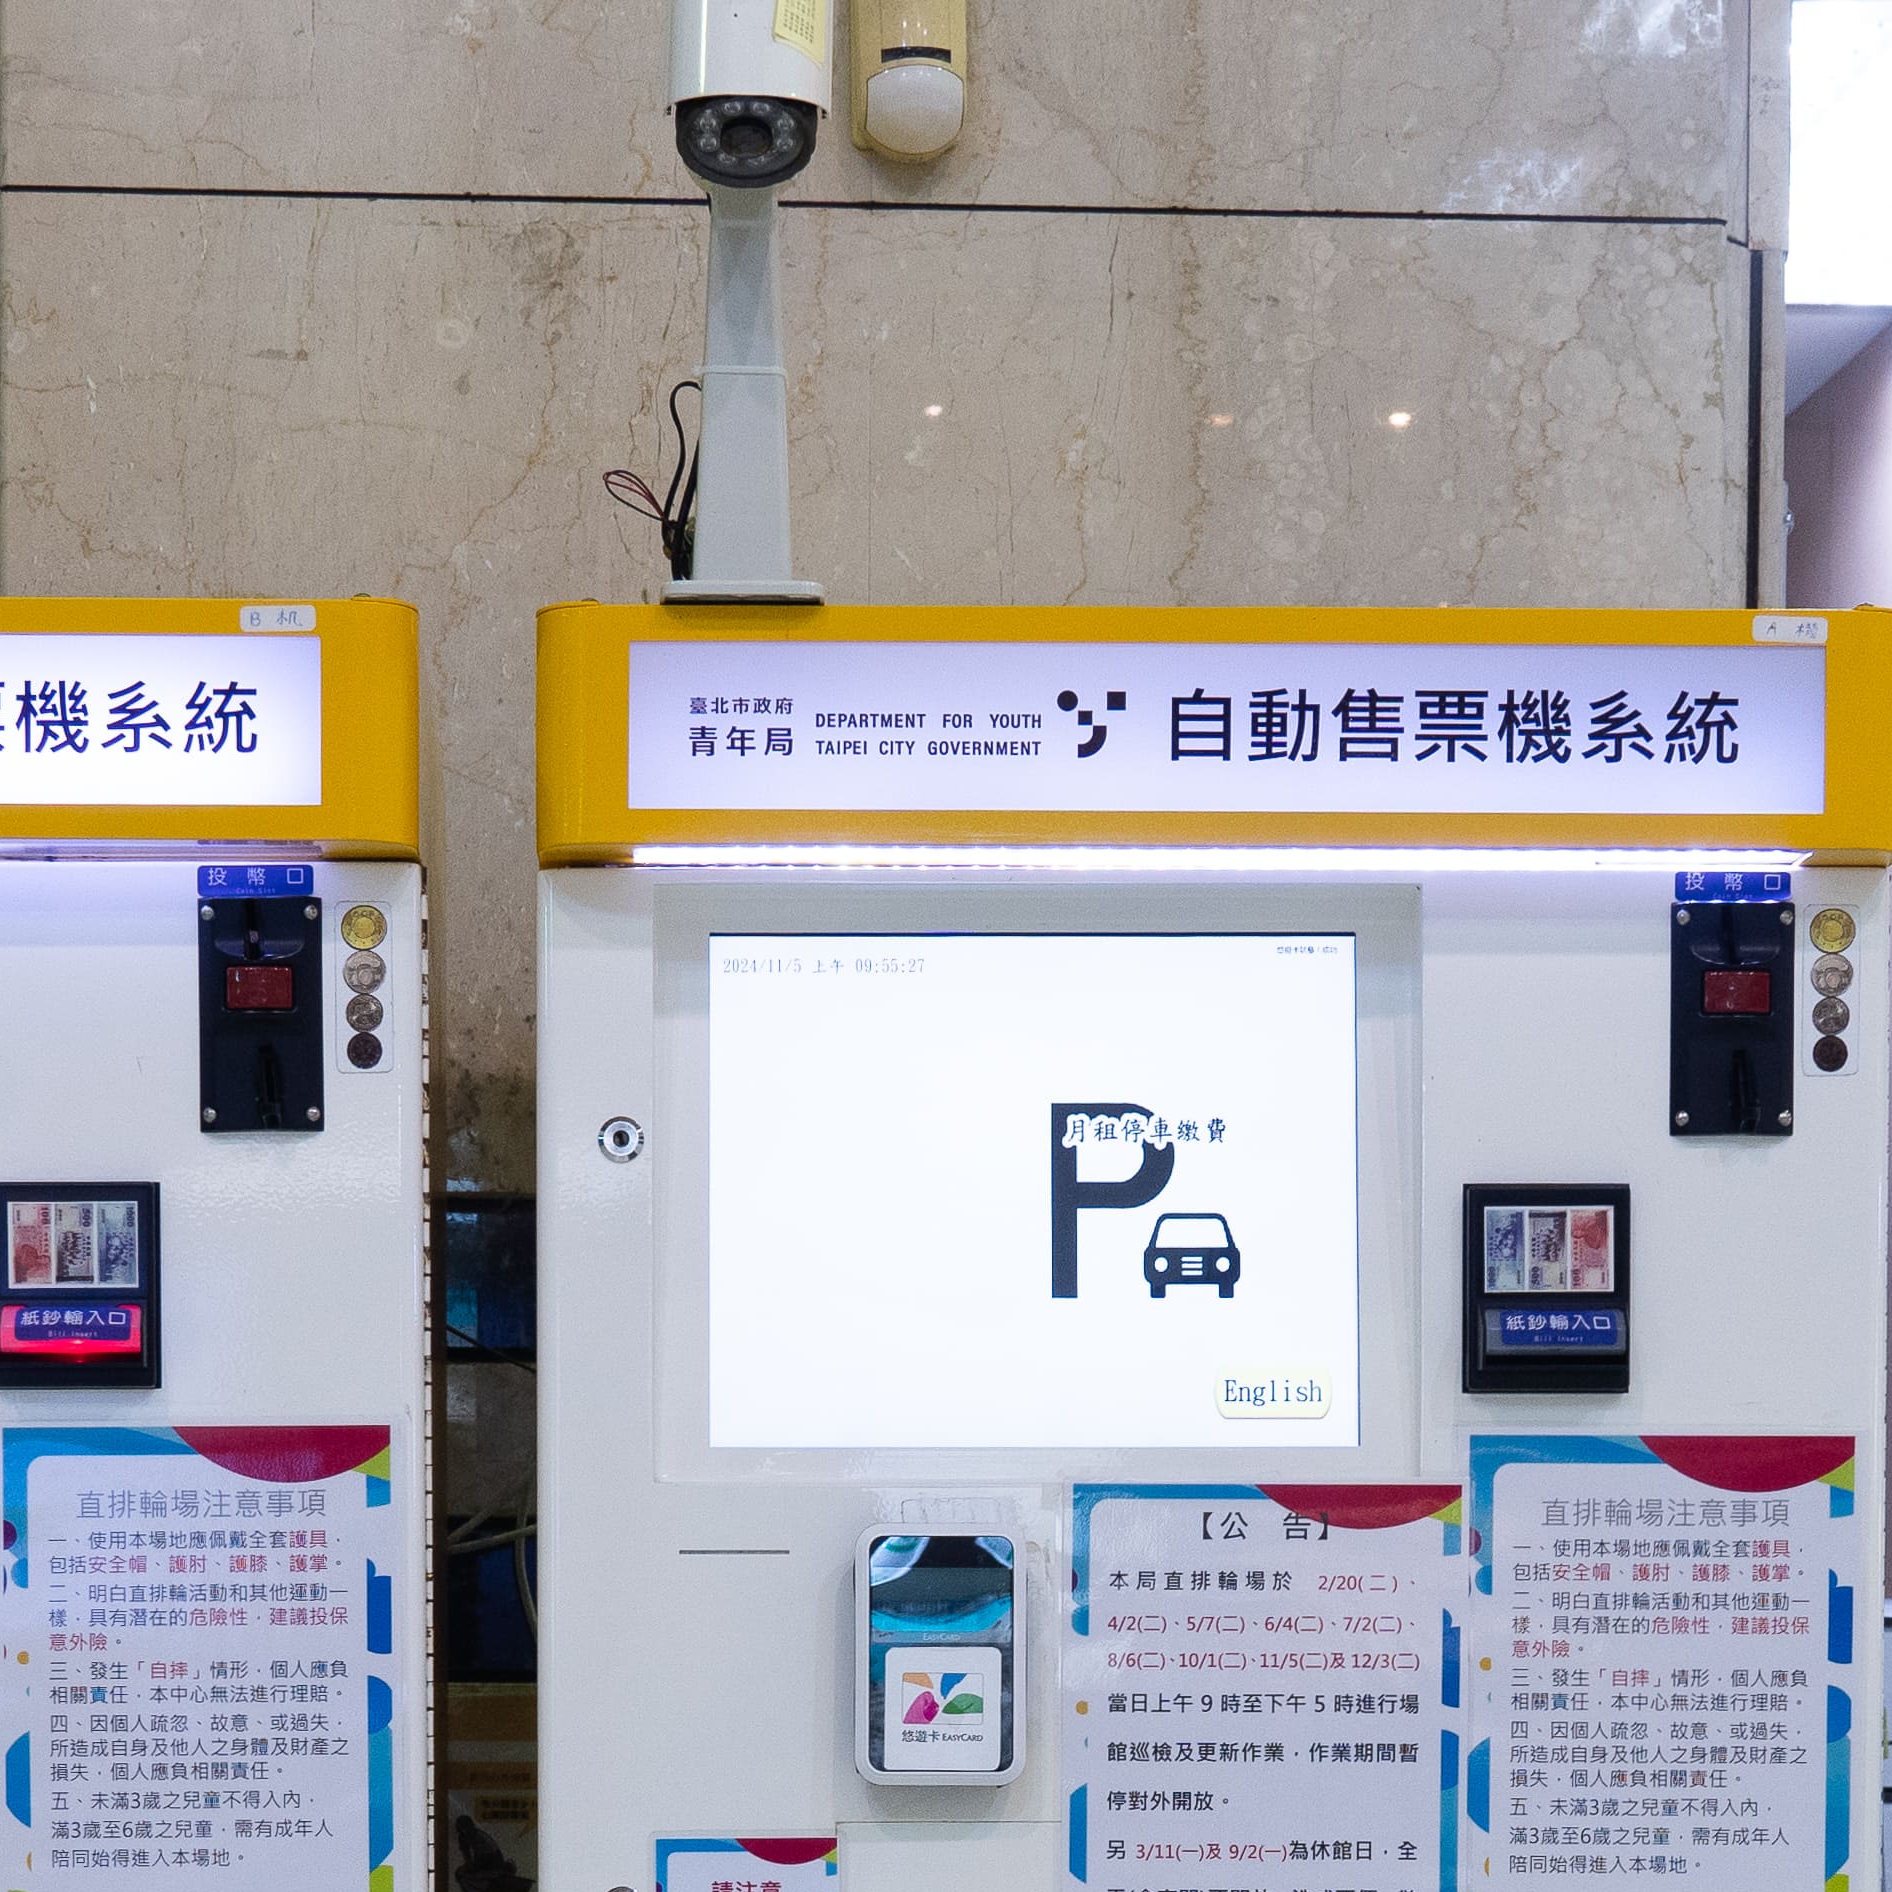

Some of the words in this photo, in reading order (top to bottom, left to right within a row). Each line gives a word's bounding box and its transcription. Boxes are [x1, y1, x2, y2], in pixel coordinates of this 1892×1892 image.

[690, 697, 792, 714] 臺北市政府
[816, 713, 926, 728] DEPARTMENT
[943, 714, 972, 728] FOR
[990, 714, 1041, 728] YOUTH
[1172, 688, 1738, 764] 自動售票機系統
[689, 726, 793, 756] 青年局
[816, 741, 867, 755] TAIPEI
[879, 741, 915, 755] CITY
[928, 741, 1041, 755] GOVERNMENT
[208, 868, 303, 886] 投幣口
[1686, 872, 1780, 891] 投幣口
[723, 957, 802, 975] 2024/11/5
[812, 959, 846, 974] 上午
[855, 957, 925, 974] 09:55:27
[1066, 1117, 1228, 1144] 月租停車繳費
[21, 1310, 127, 1325] 紙鈔輸入口
[1506, 1315, 1611, 1330] 紙鈔輸入口
[1223, 1379, 1323, 1407] English
[77, 1489, 326, 1519] 直排輪場注意事項
[1542, 1498, 1789, 1527] 直排輪場注意事項
[1110, 1571, 1292, 1591] 本局直排輪場於
[902, 1729, 940, 1743] 悠遊卡
[1107, 1791, 1228, 1811] 停對外開放。
